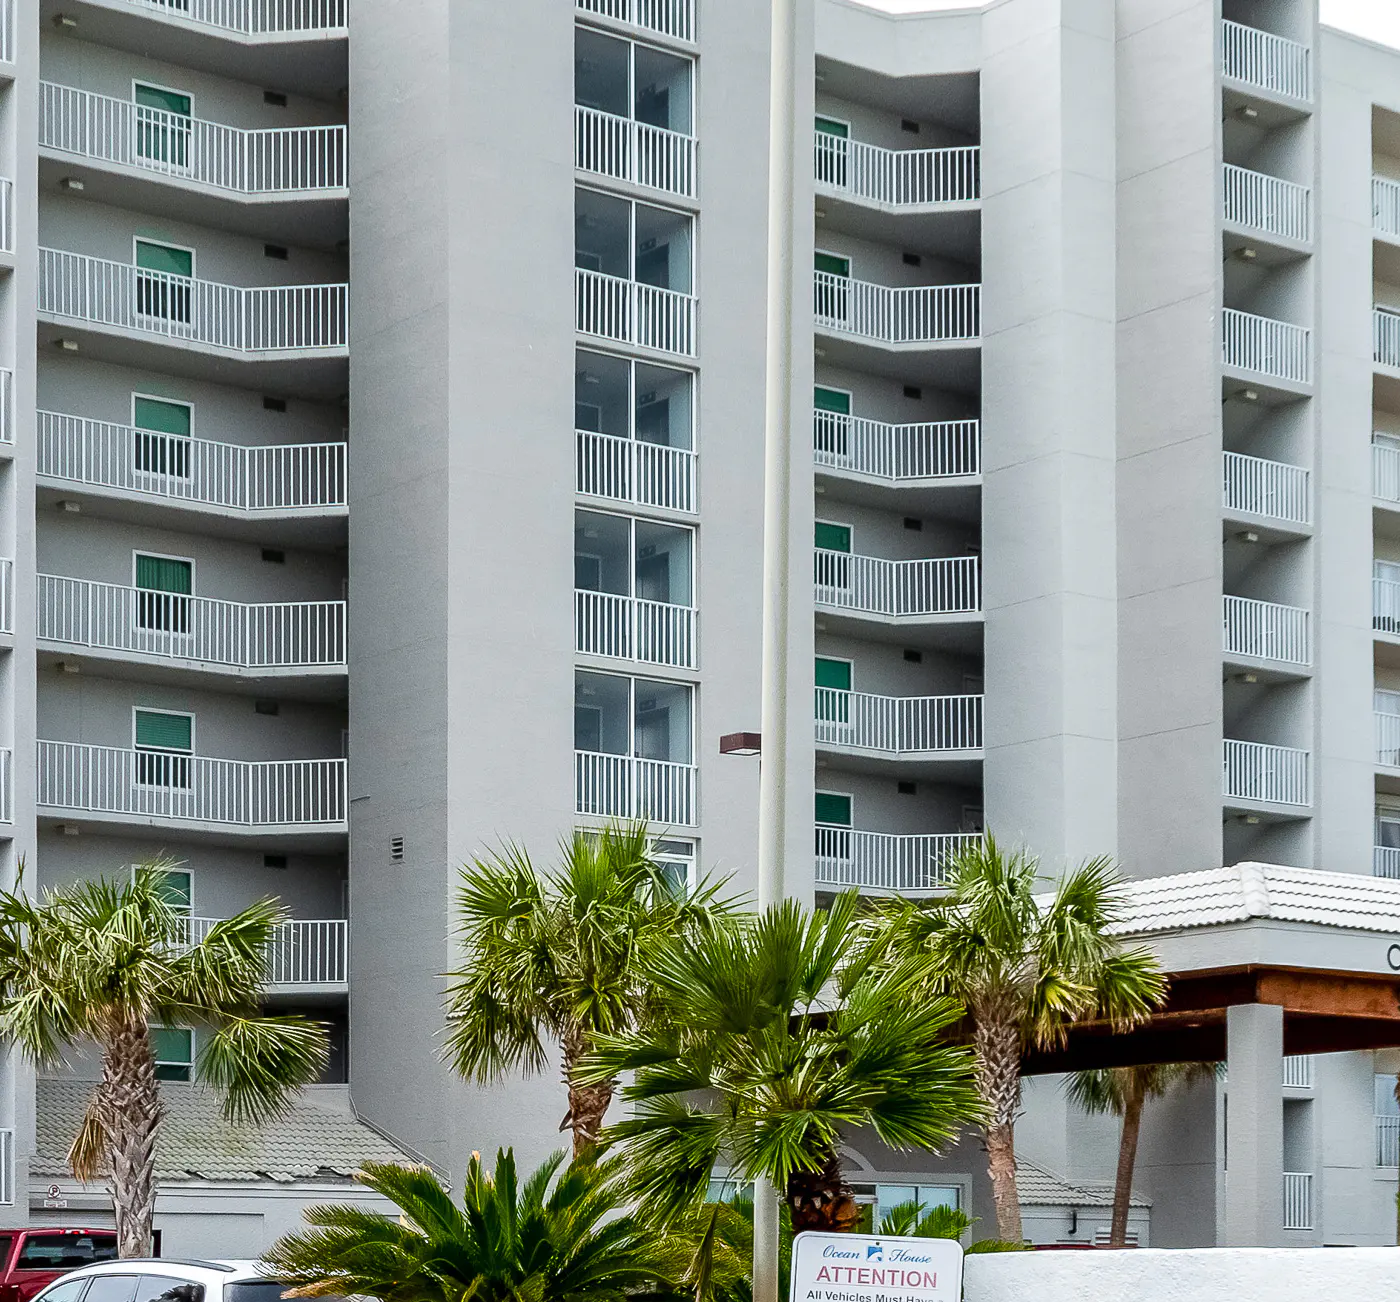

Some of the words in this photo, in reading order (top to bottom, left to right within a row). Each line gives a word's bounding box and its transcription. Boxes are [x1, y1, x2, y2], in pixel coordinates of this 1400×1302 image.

[822, 1244, 860, 1259] Ocean
[888, 1248, 932, 1264] House
[816, 1265, 937, 1288] ATTENTION
[806, 1290, 822, 1300] All
[825, 1291, 872, 1302] Vehicles
